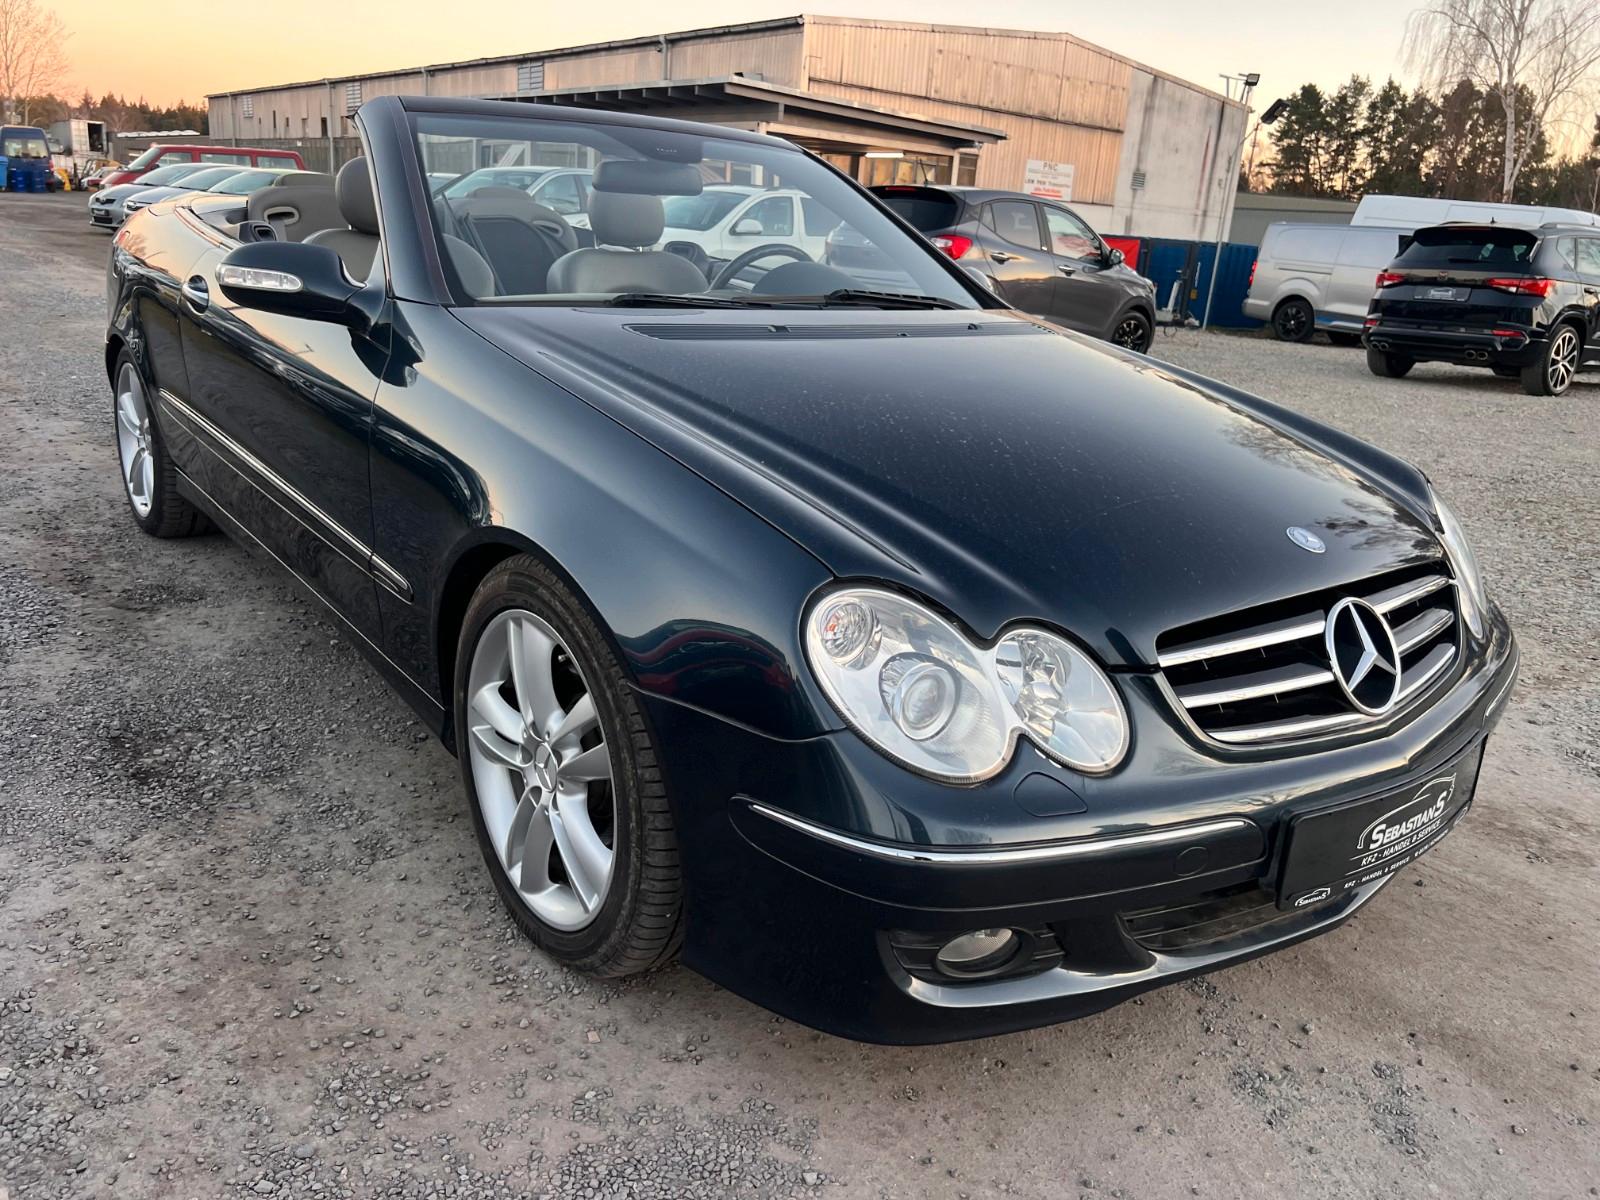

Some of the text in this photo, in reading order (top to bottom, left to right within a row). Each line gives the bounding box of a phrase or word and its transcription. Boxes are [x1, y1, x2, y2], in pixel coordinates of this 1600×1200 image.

[1361, 853, 1378, 866] KFZ
[1383, 838, 1411, 857] HANDEL
[1417, 819, 1441, 840] SERVICE
